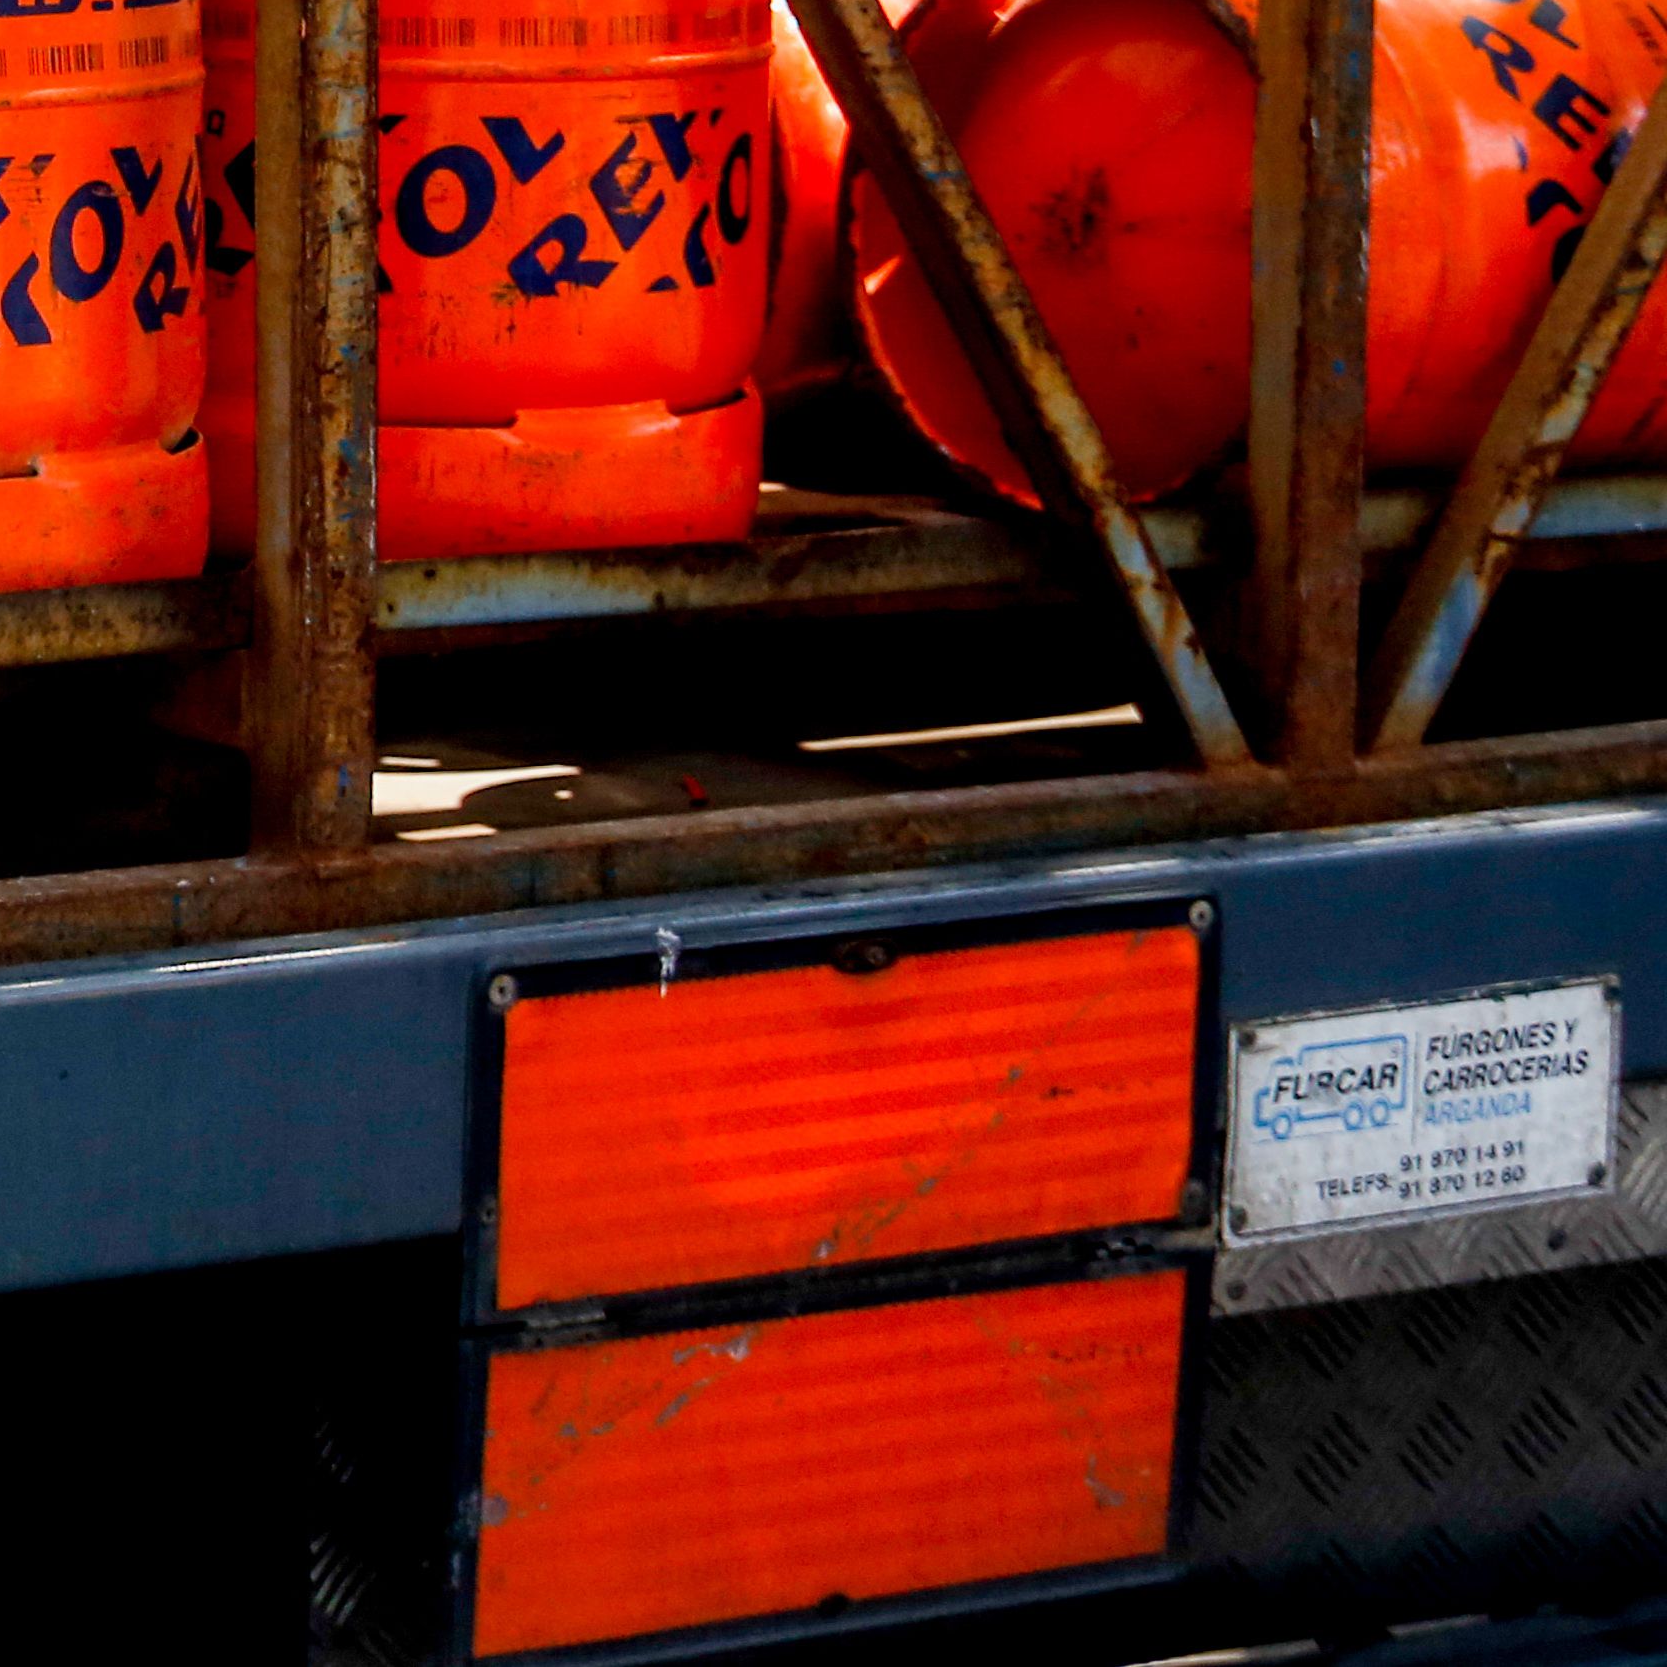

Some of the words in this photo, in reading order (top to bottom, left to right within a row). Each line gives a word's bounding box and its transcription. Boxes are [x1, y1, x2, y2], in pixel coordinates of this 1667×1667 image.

[1425, 1022, 1557, 1062] FURGONES
[1563, 1020, 1579, 1043] Y
[1422, 1049, 1590, 1097] CARROCERIAS
[1424, 1091, 1533, 1126] ARGANDA
